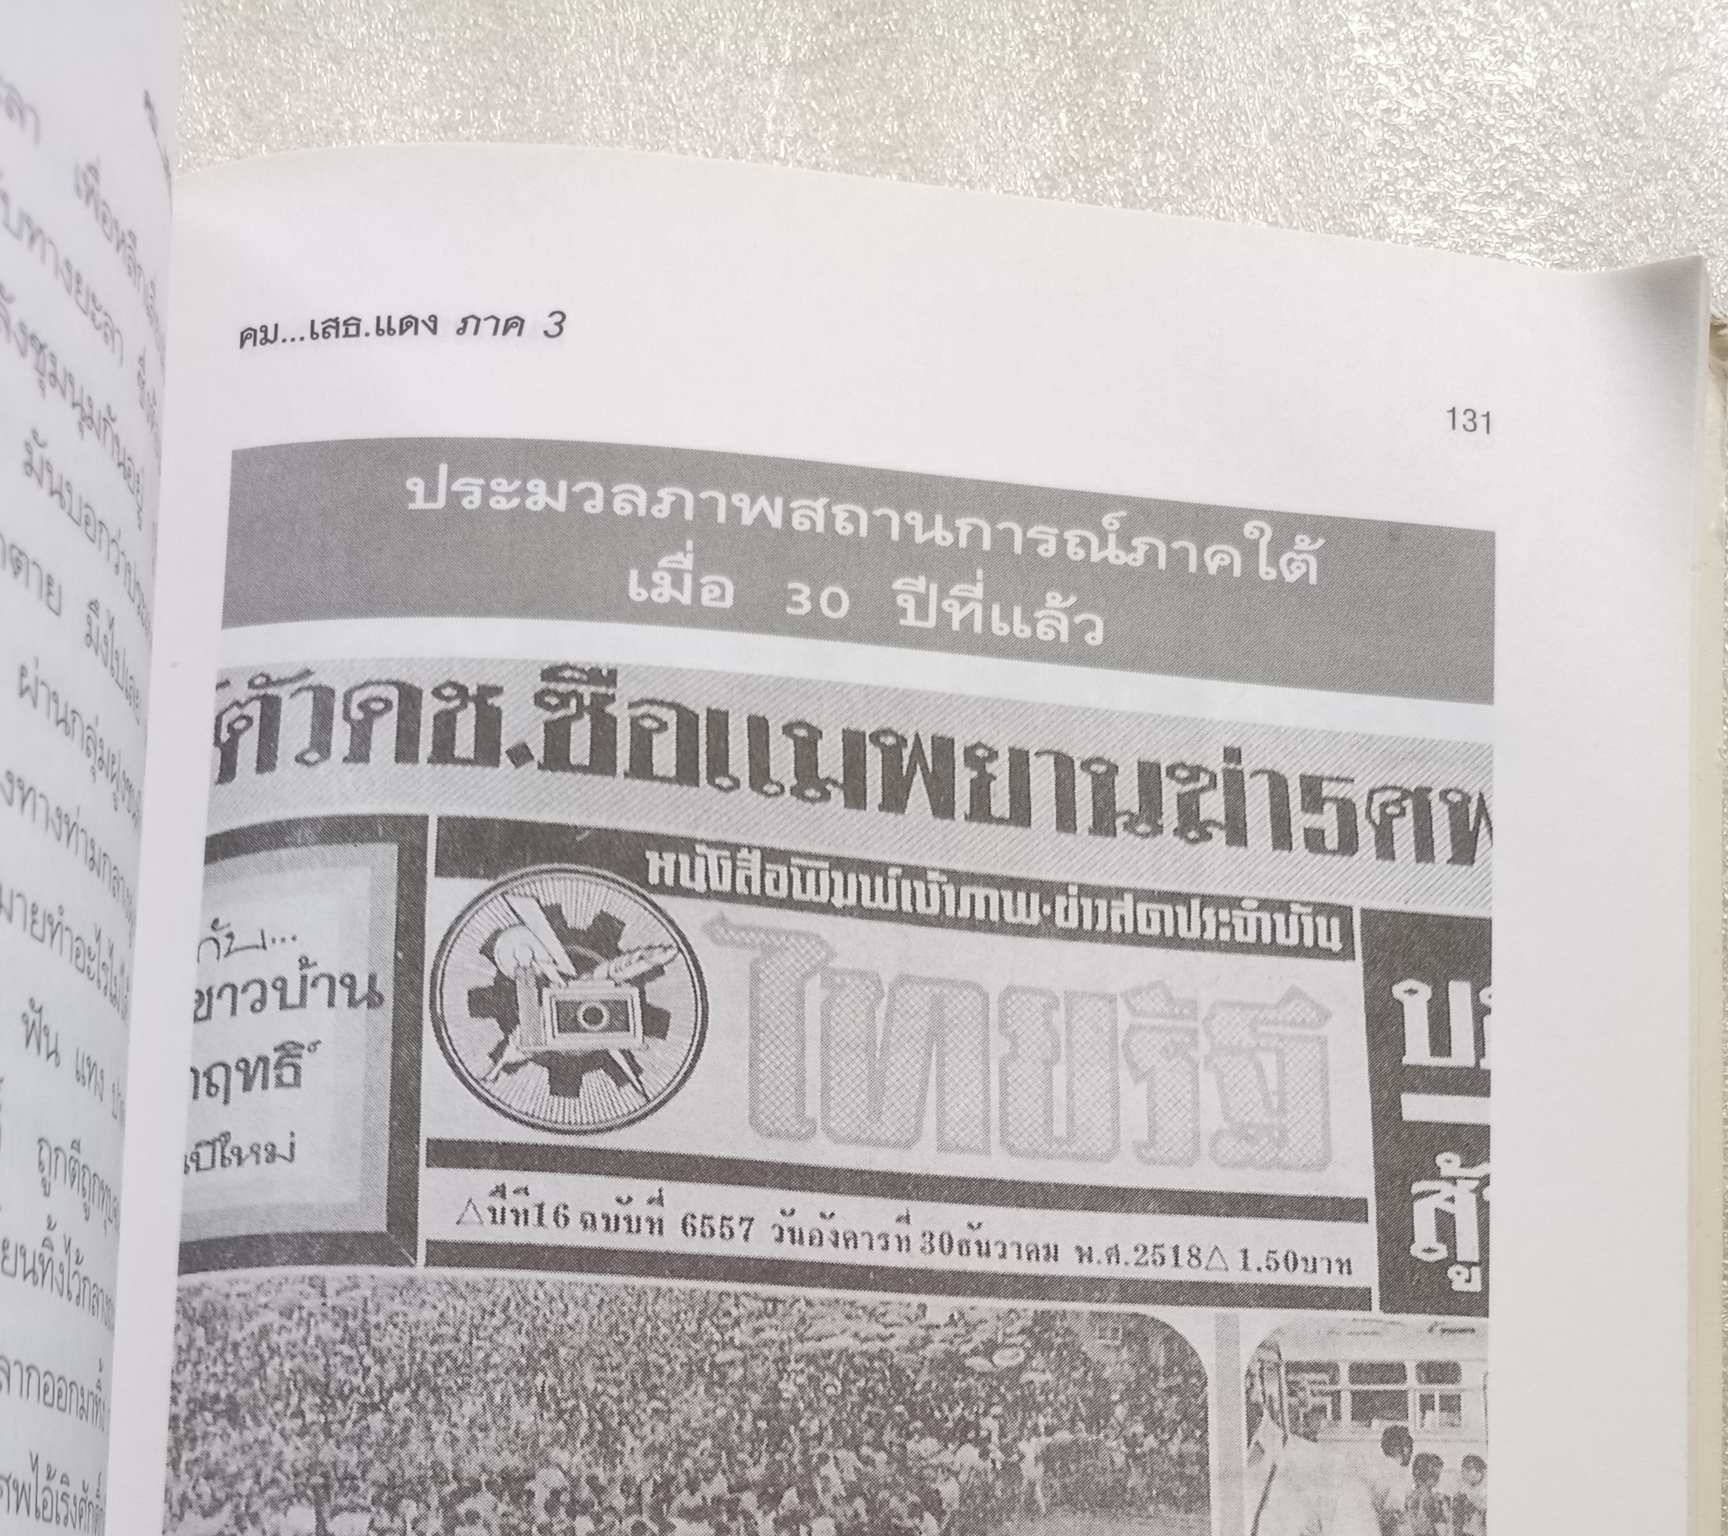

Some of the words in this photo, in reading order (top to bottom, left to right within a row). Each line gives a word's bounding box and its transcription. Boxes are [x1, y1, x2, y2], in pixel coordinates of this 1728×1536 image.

[455, 311, 527, 339] ภาค
[542, 308, 567, 340] 3
[1445, 405, 1492, 436] 131
[406, 463, 1326, 586] ประมวลภาพสถานการณ์ภาคใต้
[627, 541, 734, 609] เมื่อ
[784, 582, 851, 620] 30
[892, 569, 1105, 646] ปีที่แล้ว
[701, 909, 1334, 1172] ไทยรัฐ
[680, 1210, 756, 1244] 6557
